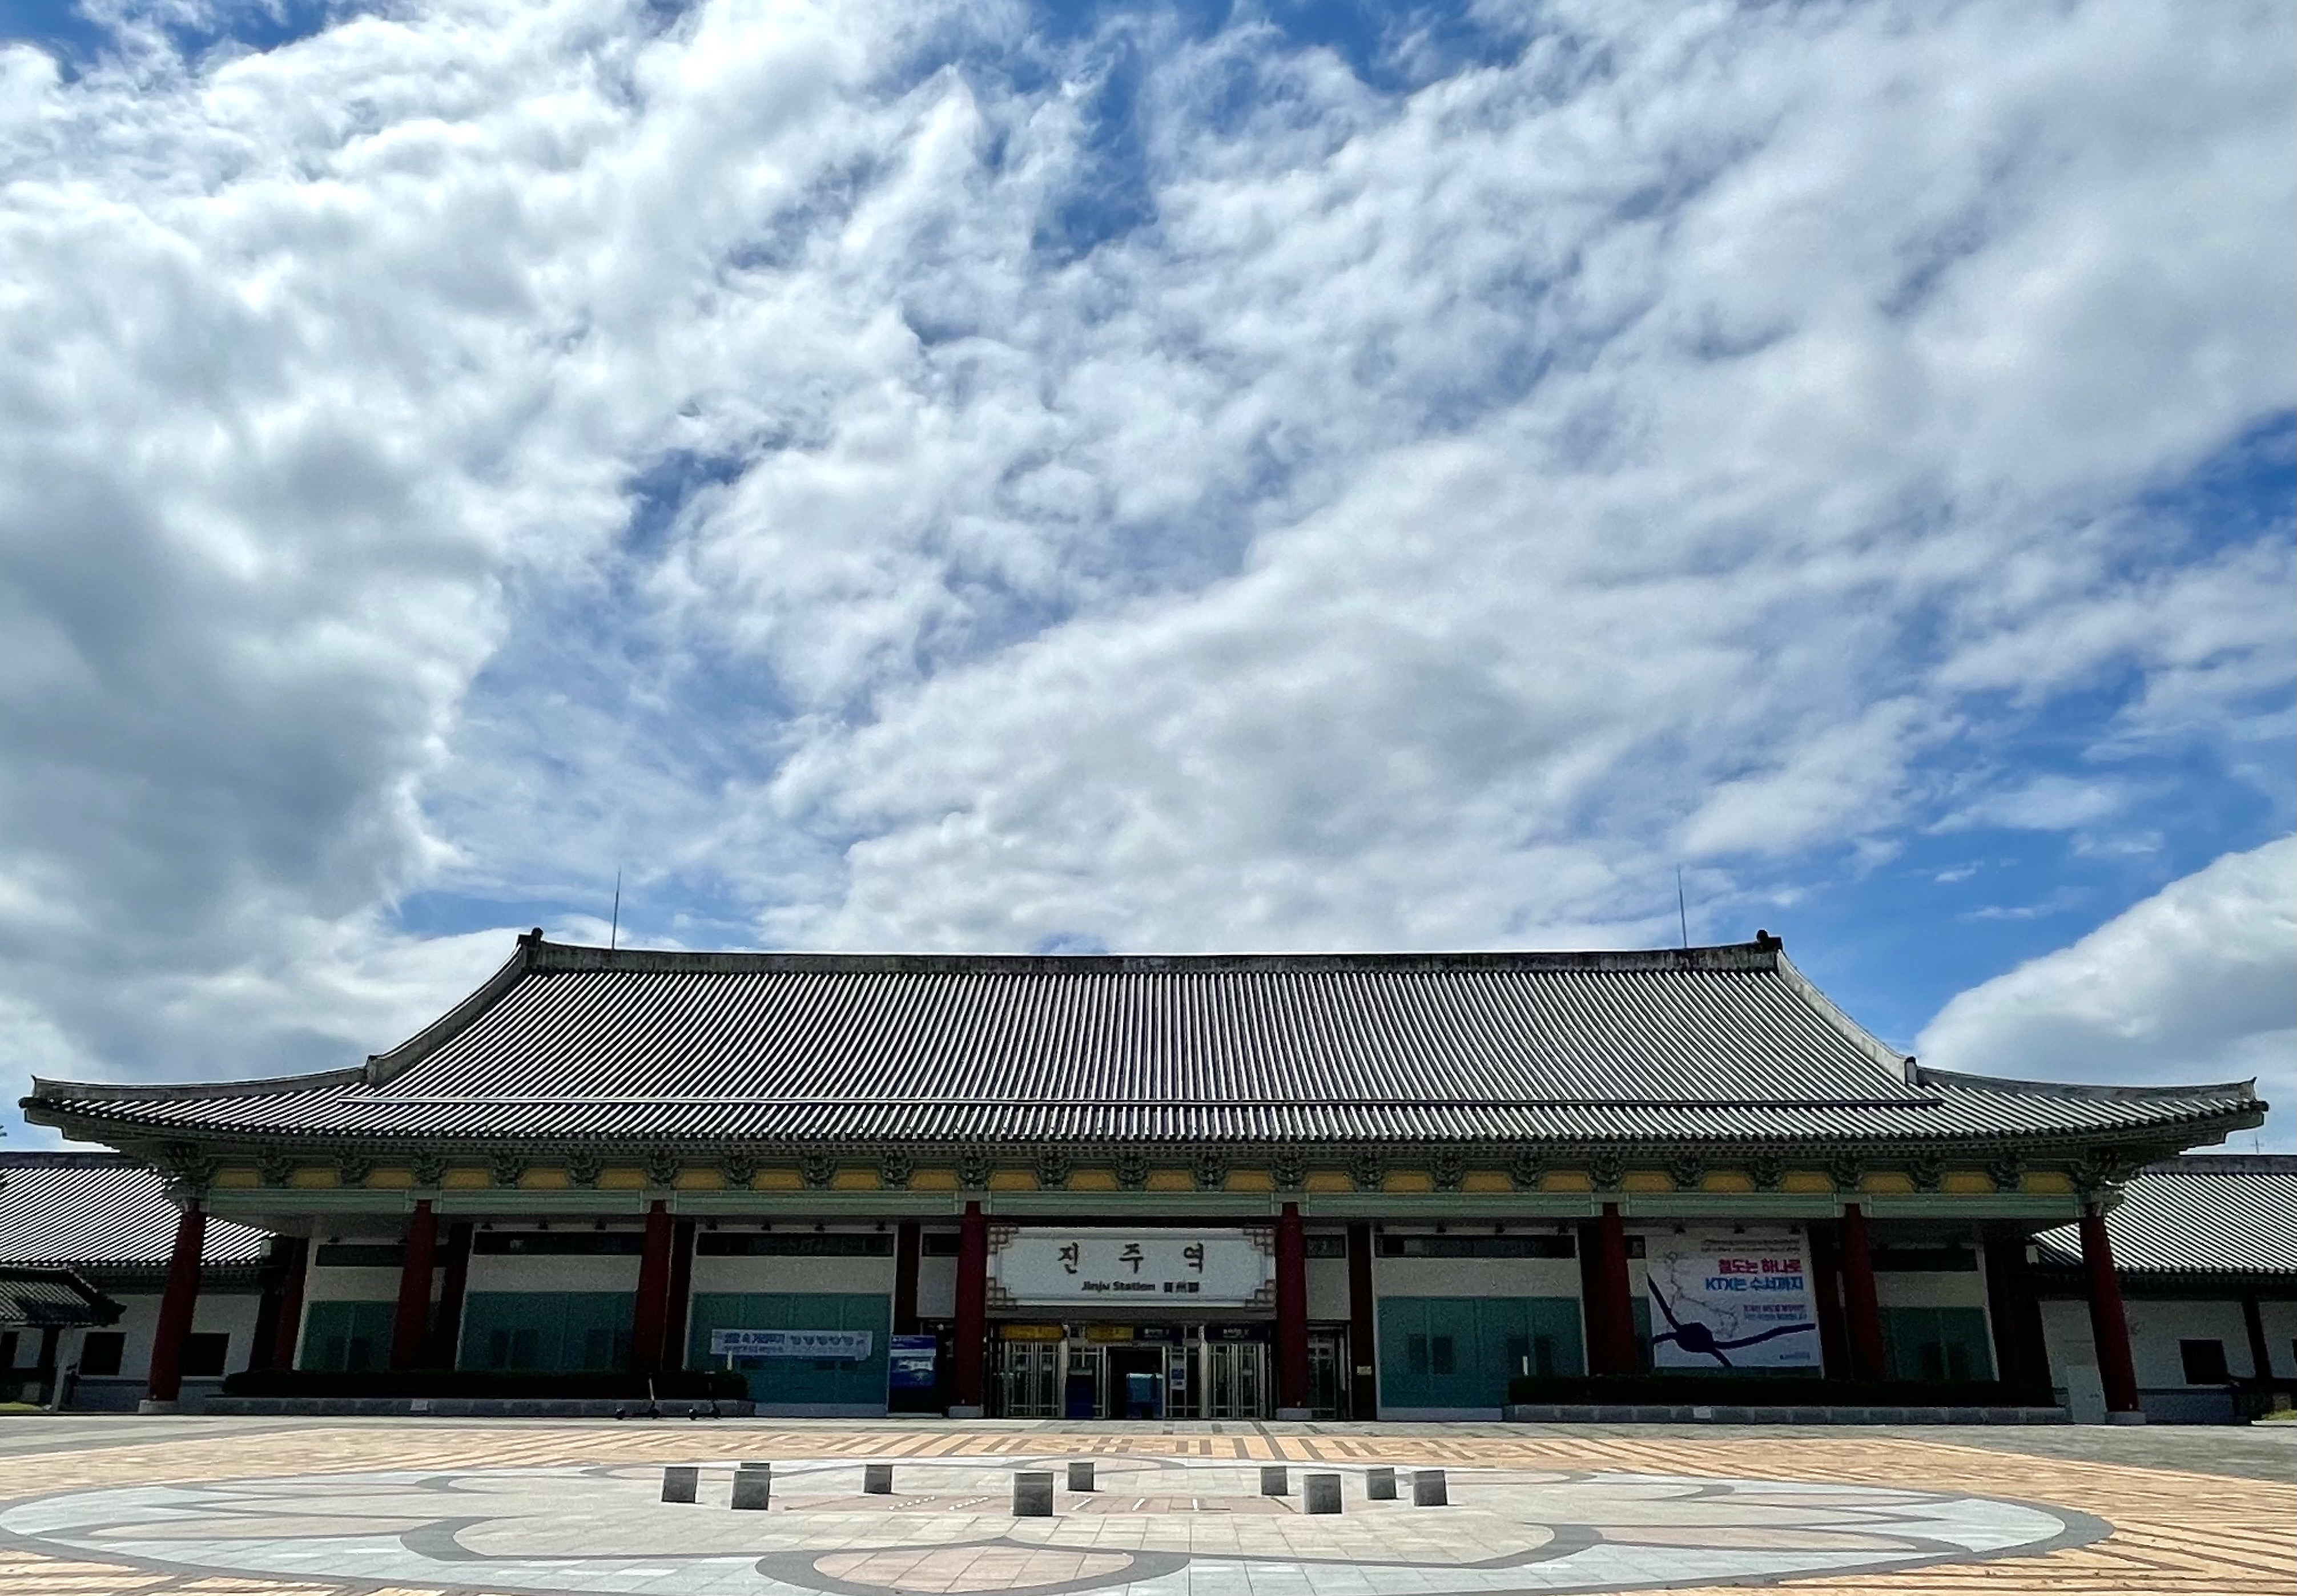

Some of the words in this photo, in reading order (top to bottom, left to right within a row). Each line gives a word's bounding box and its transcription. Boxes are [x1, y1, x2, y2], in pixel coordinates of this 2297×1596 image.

[1057, 1241, 1204, 1274] 진주역
[1719, 1258, 1759, 1274] 철도는
[1761, 1258, 1803, 1273] 하나로
[1081, 1281, 1110, 1292] Jinju
[1112, 1280, 1156, 1291] Station
[1705, 1276, 1747, 1291] KTX는
